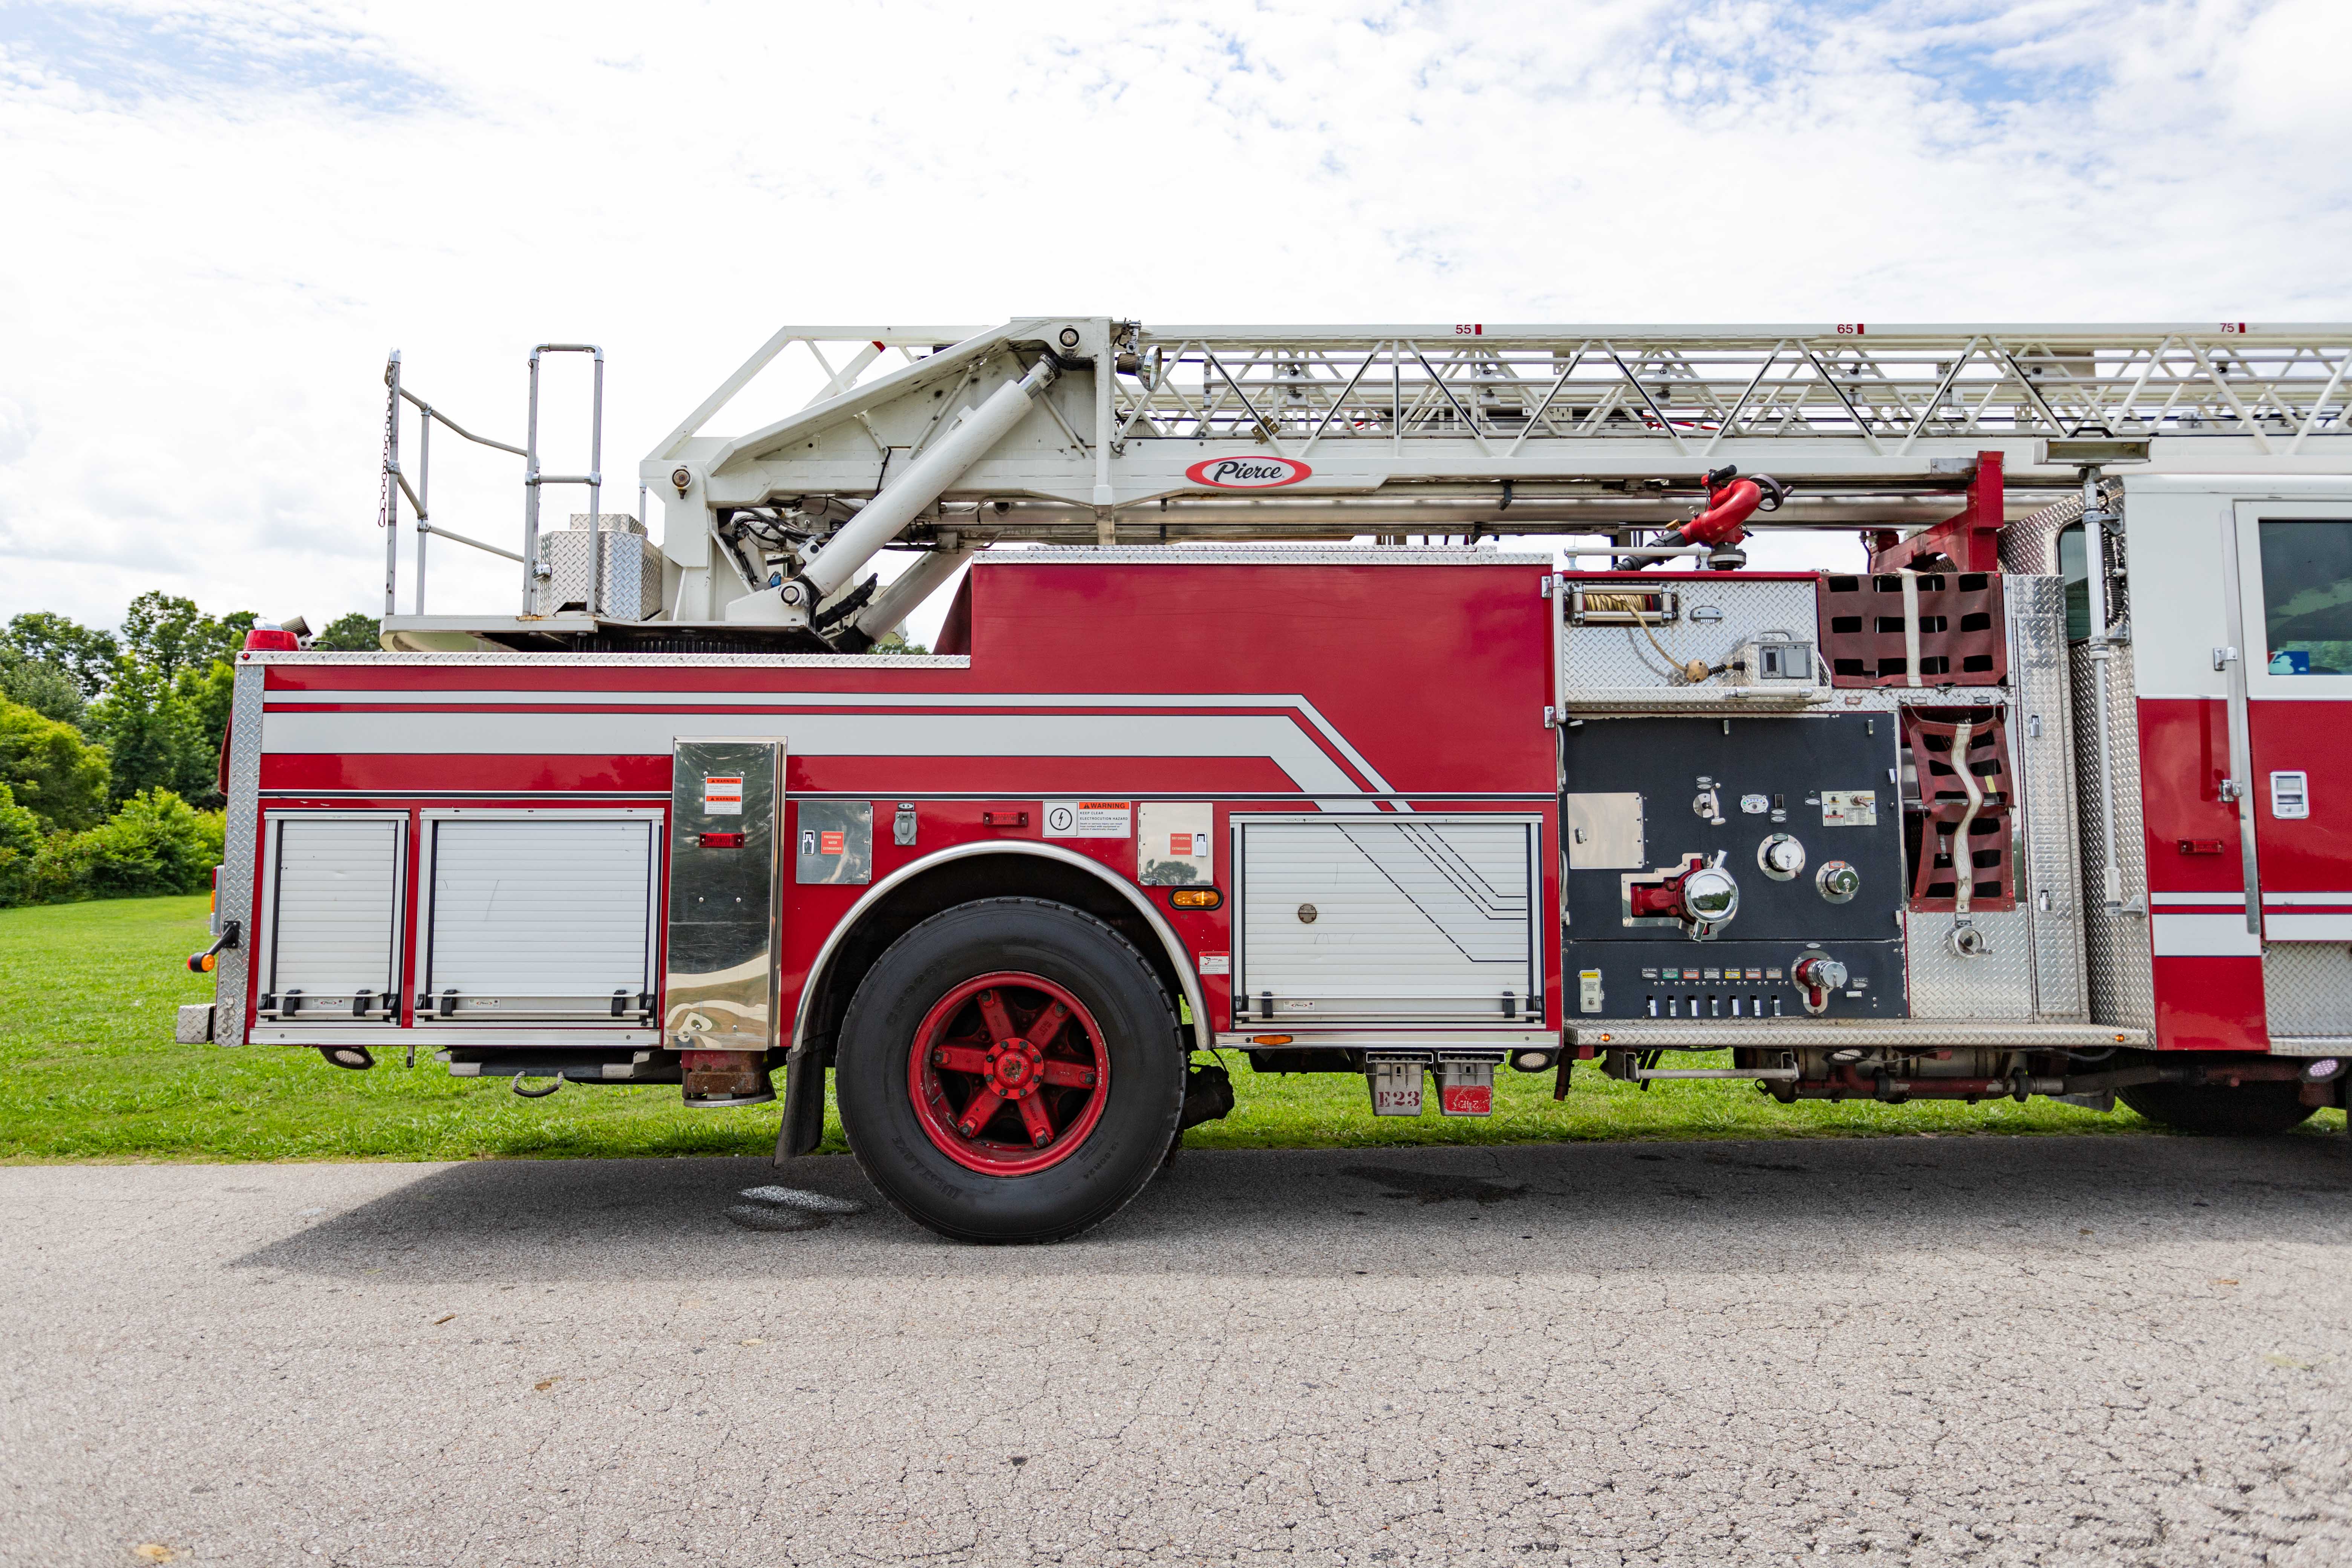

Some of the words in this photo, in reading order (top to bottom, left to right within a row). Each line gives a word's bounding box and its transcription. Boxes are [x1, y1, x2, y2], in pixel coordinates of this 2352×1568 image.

[1455, 324, 1472, 334] 55
[1837, 324, 1853, 334] 65
[2220, 323, 2235, 333] 75
[1213, 460, 1283, 482] Pierce
[1378, 1091, 1420, 1107] E23
